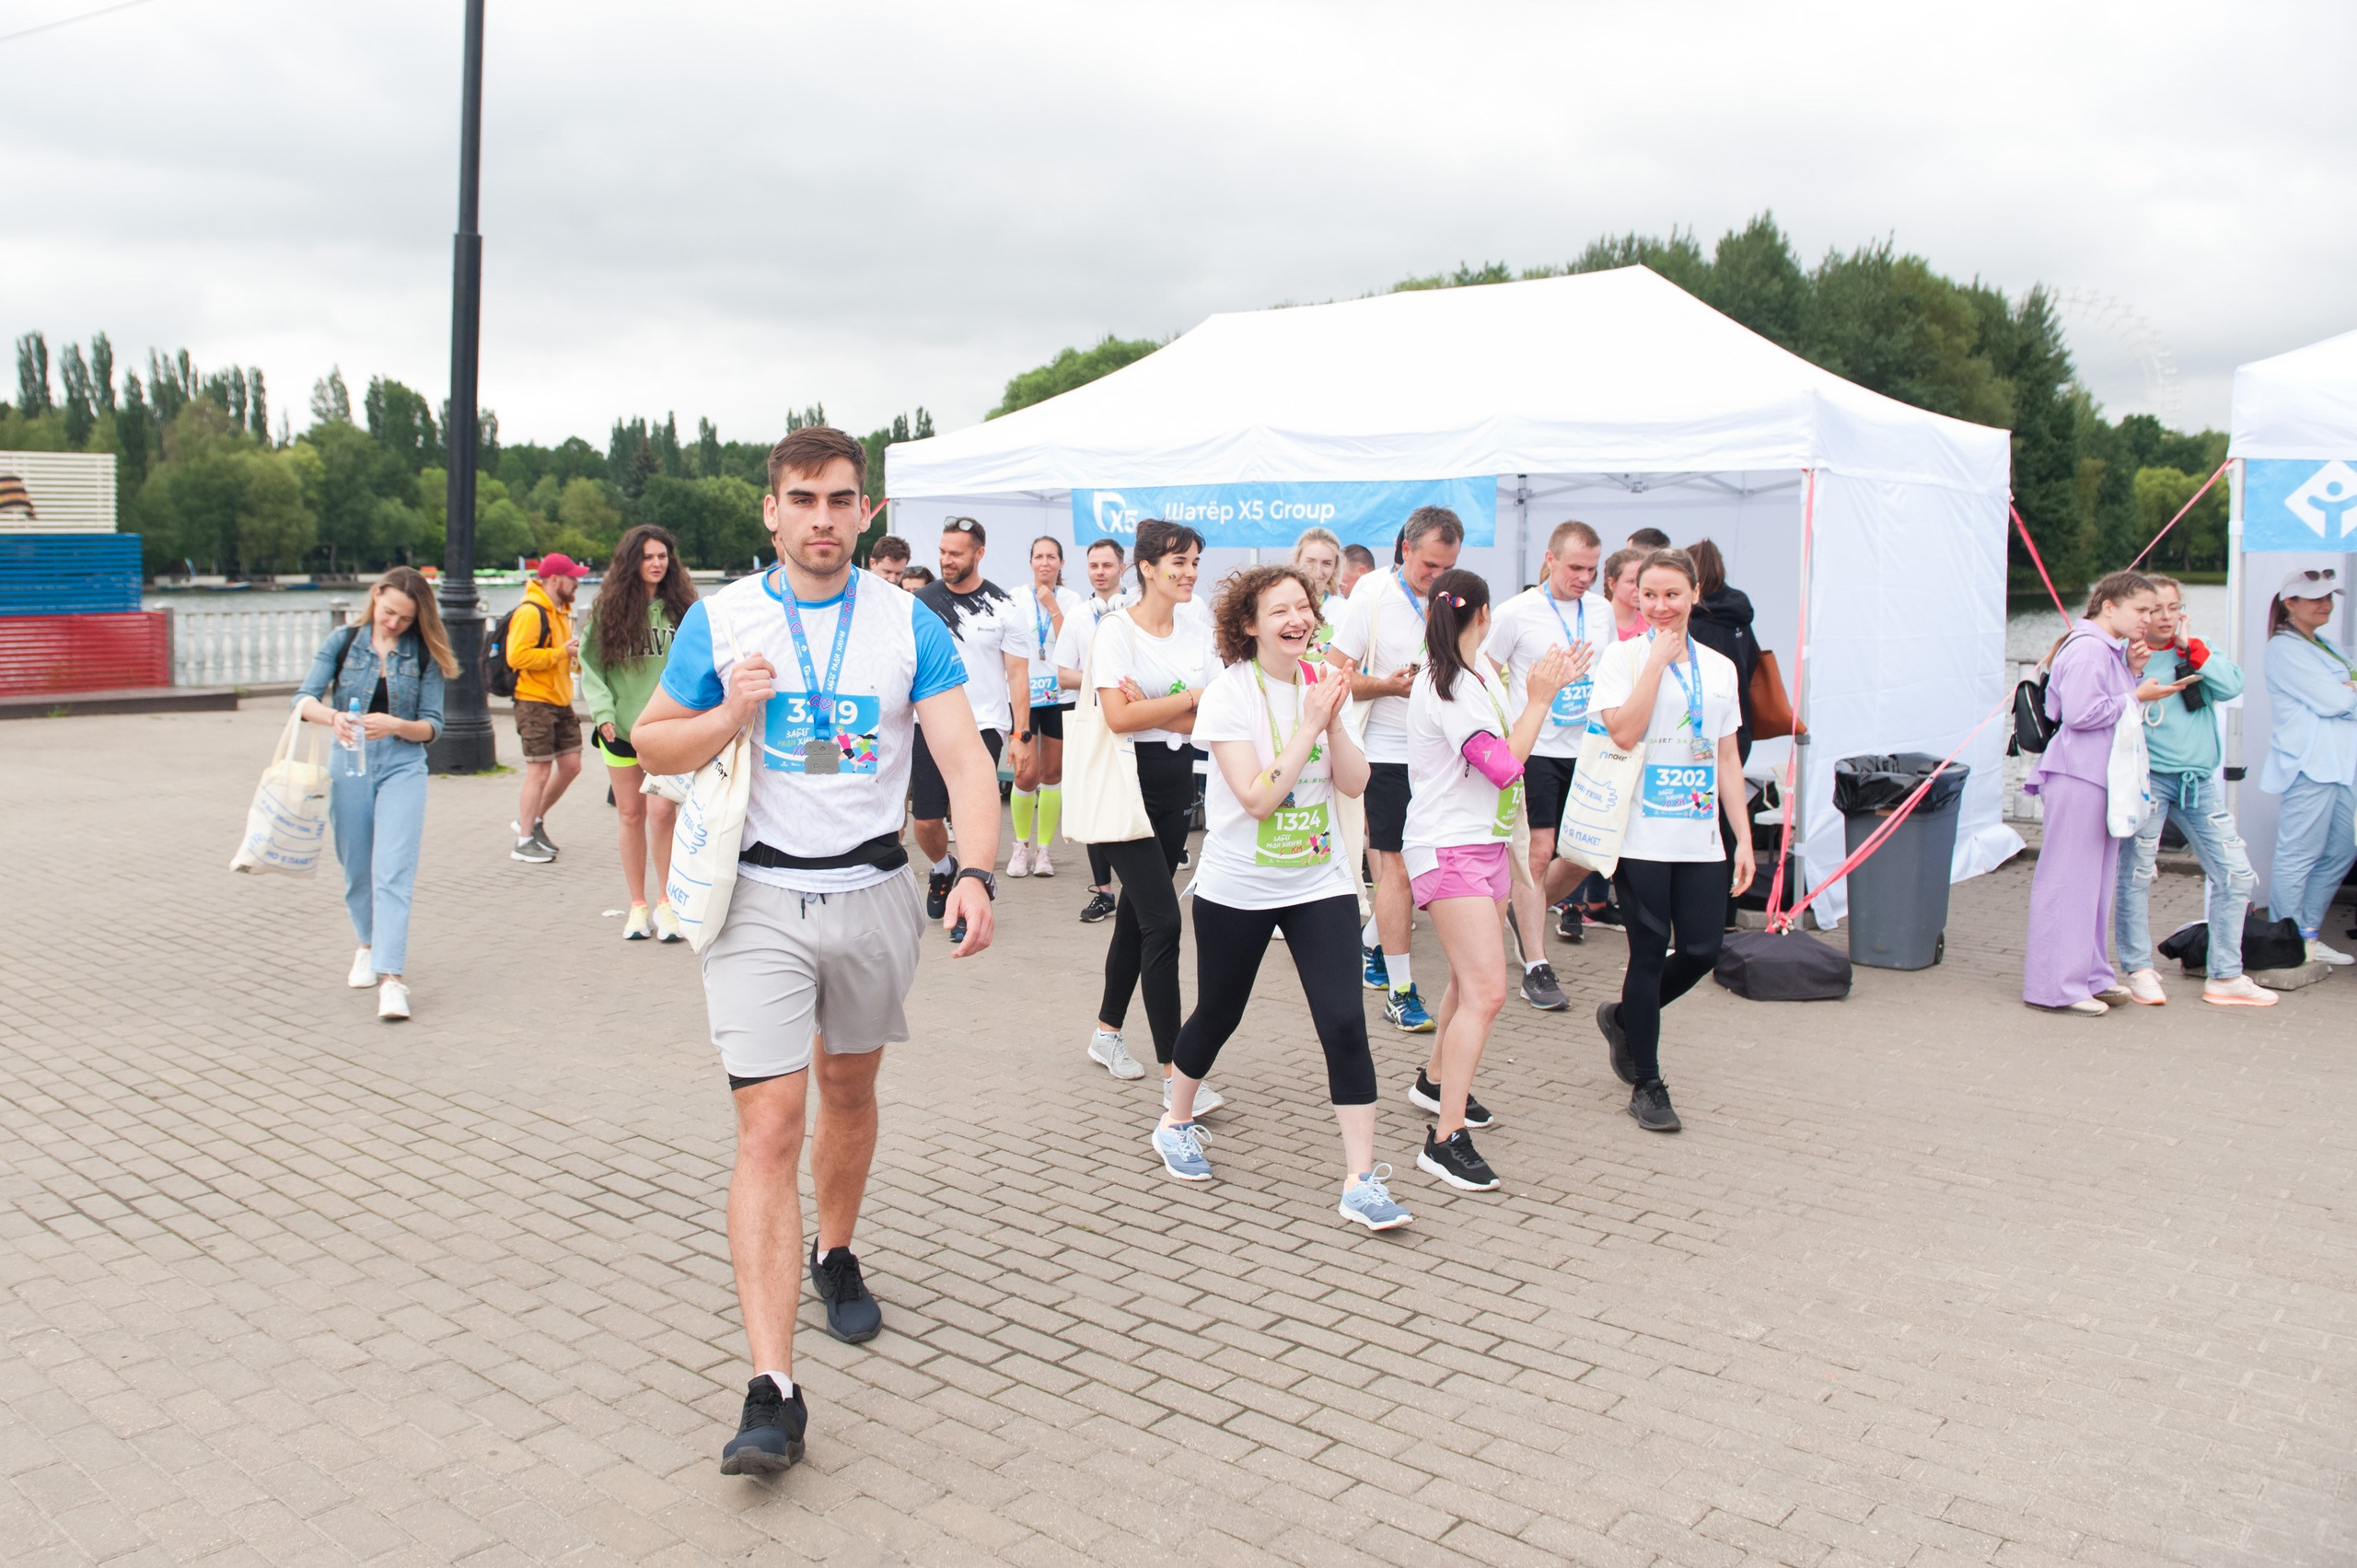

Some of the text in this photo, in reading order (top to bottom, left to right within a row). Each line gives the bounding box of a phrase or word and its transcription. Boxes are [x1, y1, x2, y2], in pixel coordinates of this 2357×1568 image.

[1109, 508, 1138, 534] X5
[1165, 499, 1335, 525] Шатёр X5 Group
[1030, 678, 1052, 690] 207
[1655, 768, 1707, 787] 3202
[1274, 809, 1321, 831] 1324
[1575, 831, 1601, 846] ПАКЕТ
